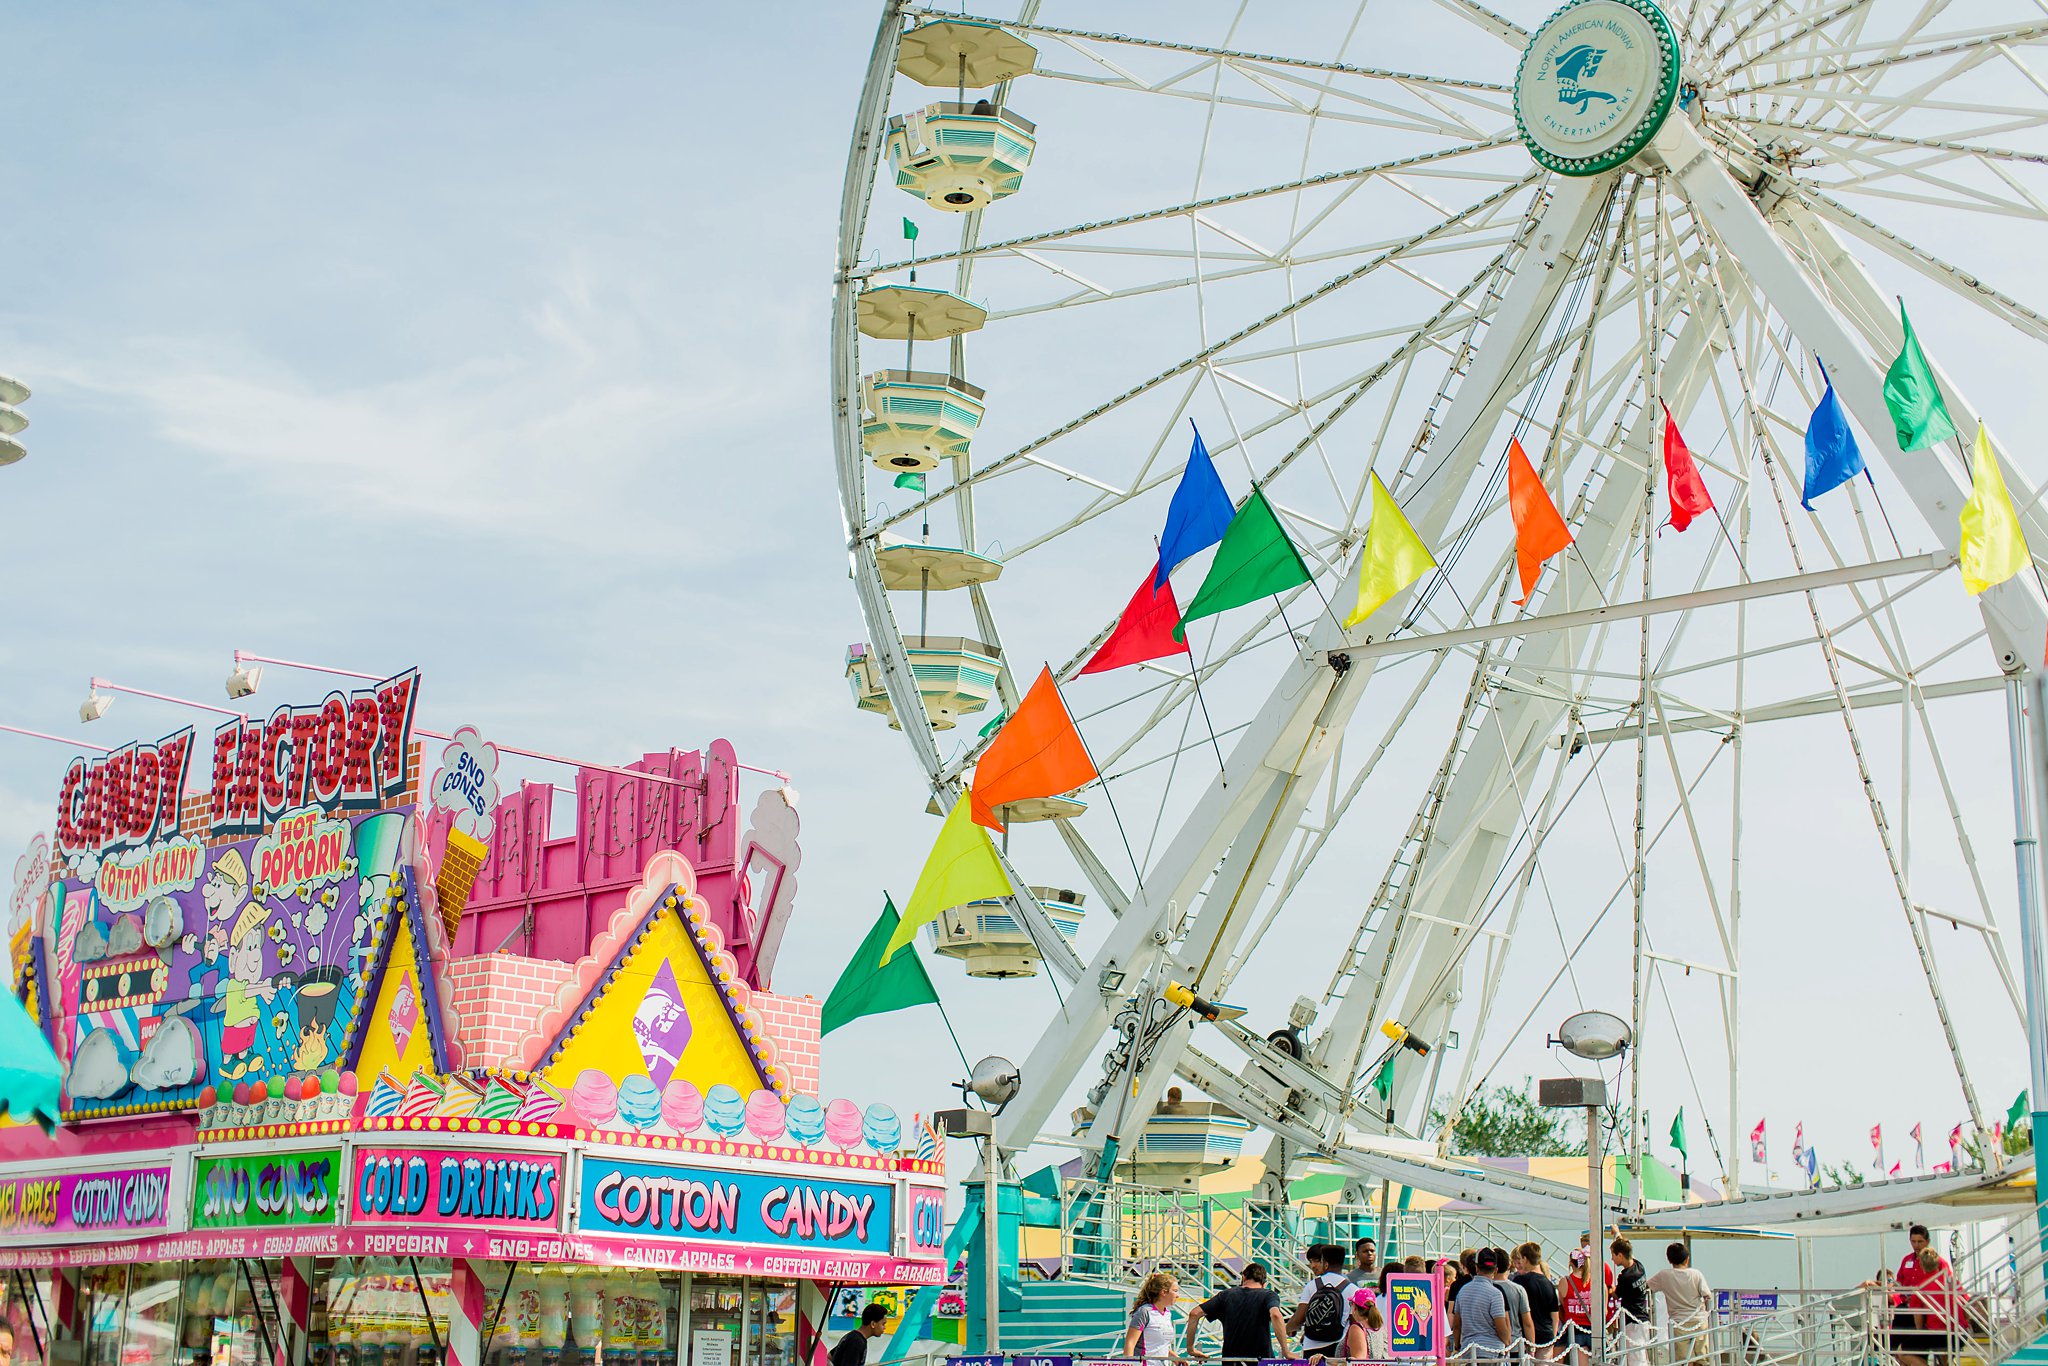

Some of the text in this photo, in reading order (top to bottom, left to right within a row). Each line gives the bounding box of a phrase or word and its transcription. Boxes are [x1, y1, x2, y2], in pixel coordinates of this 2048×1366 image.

[1537, 19, 1635, 81] NORTH AMERICAN MIDWAY
[1544, 87, 1633, 136] ENTERTAINMENT
[58, 667, 418, 858] CANDY FACTORY
[457, 752, 485, 787] SNO
[442, 772, 486, 816] CONES
[281, 813, 316, 845] HOT
[101, 847, 199, 901] COTTON CANDY
[260, 830, 343, 889] POPCORN
[18, 1180, 60, 1227] APPLES
[71, 1172, 167, 1227] COTTON CANDY
[204, 1157, 331, 1218] SNO CONES
[359, 1155, 556, 1220] COLD DRINKS
[594, 1170, 875, 1243] COTTON CANDY
[20, 1251, 54, 1266] APPLES
[69, 1248, 106, 1264] COTTON
[107, 1244, 140, 1261] CANDY
[157, 1240, 204, 1258] CARAMEL
[206, 1238, 246, 1255] APPLES
[263, 1236, 293, 1254] COLD
[294, 1235, 339, 1253] DRINKS
[364, 1235, 449, 1253] POPCORN
[489, 1238, 594, 1261] SNO-CONES
[623, 1247, 675, 1268] CANDY
[679, 1250, 736, 1270] APPLES
[763, 1256, 821, 1275] COTTON
[823, 1260, 871, 1279] CANDY
[893, 1265, 942, 1282] CARAMEL
[1397, 1307, 1409, 1331] 4
